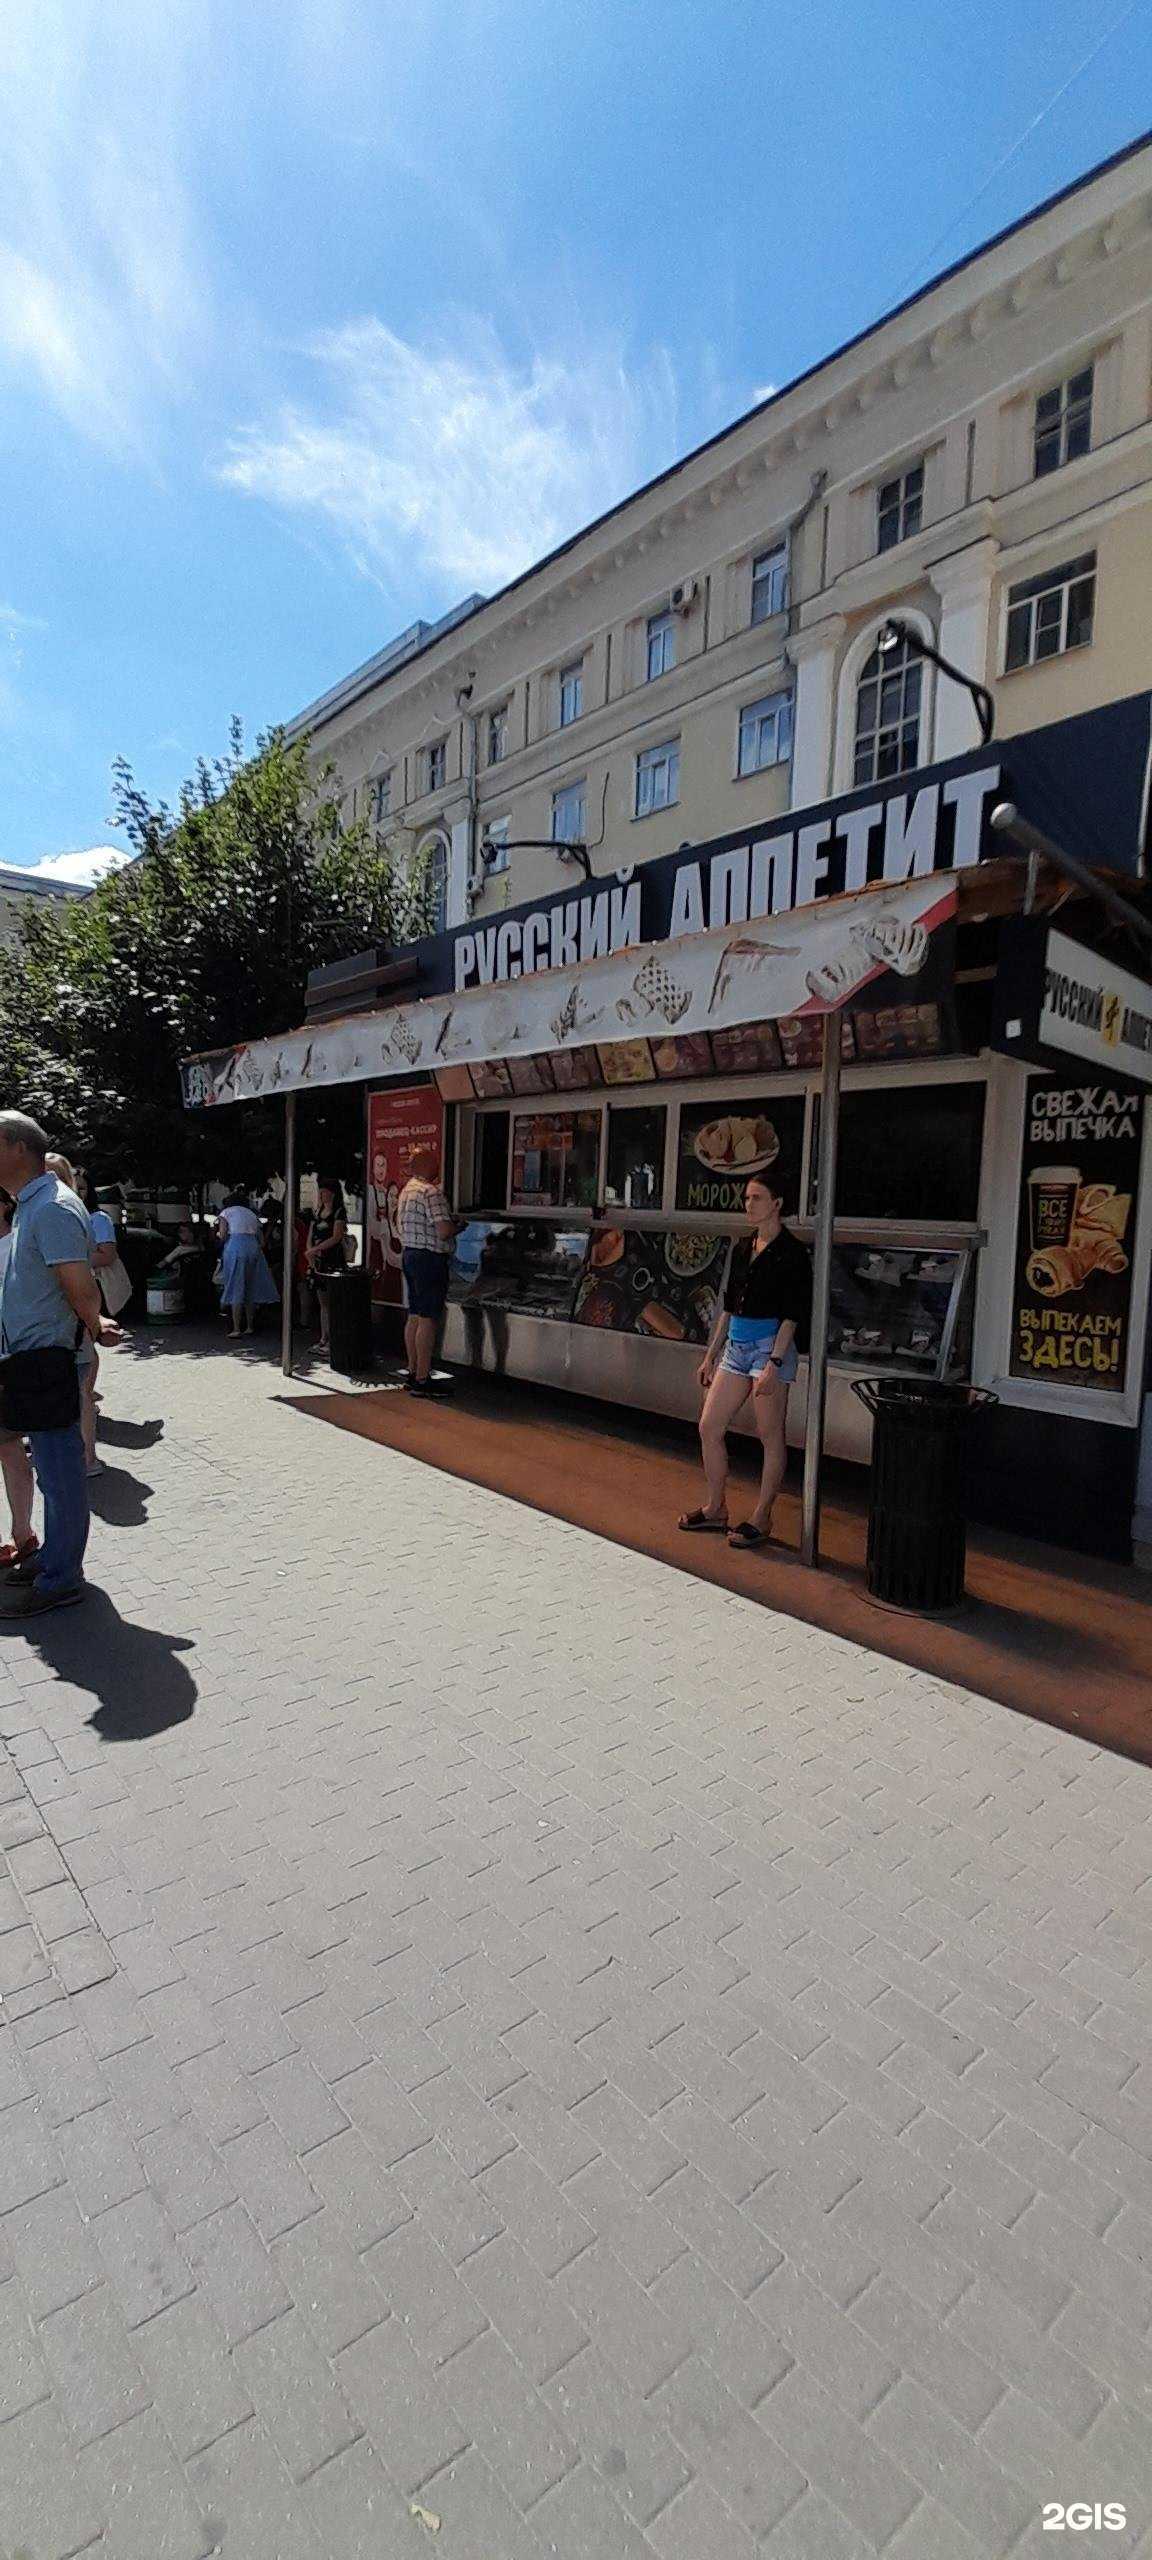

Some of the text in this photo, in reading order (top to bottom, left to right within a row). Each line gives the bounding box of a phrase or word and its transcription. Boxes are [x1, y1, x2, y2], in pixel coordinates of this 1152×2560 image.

[455, 765, 1001, 991] РУССКИЙ АППЕТИТ
[1030, 1116, 1136, 1142] ВЫПЕЧКА
[688, 1182, 745, 1209] МОРОЖ
[1039, 1200, 1068, 1217] ВСЕ
[1020, 1308, 1122, 1336] ВЫПЕКАЕМ
[1020, 1330, 1119, 1372] ЗДЕСЬ!
